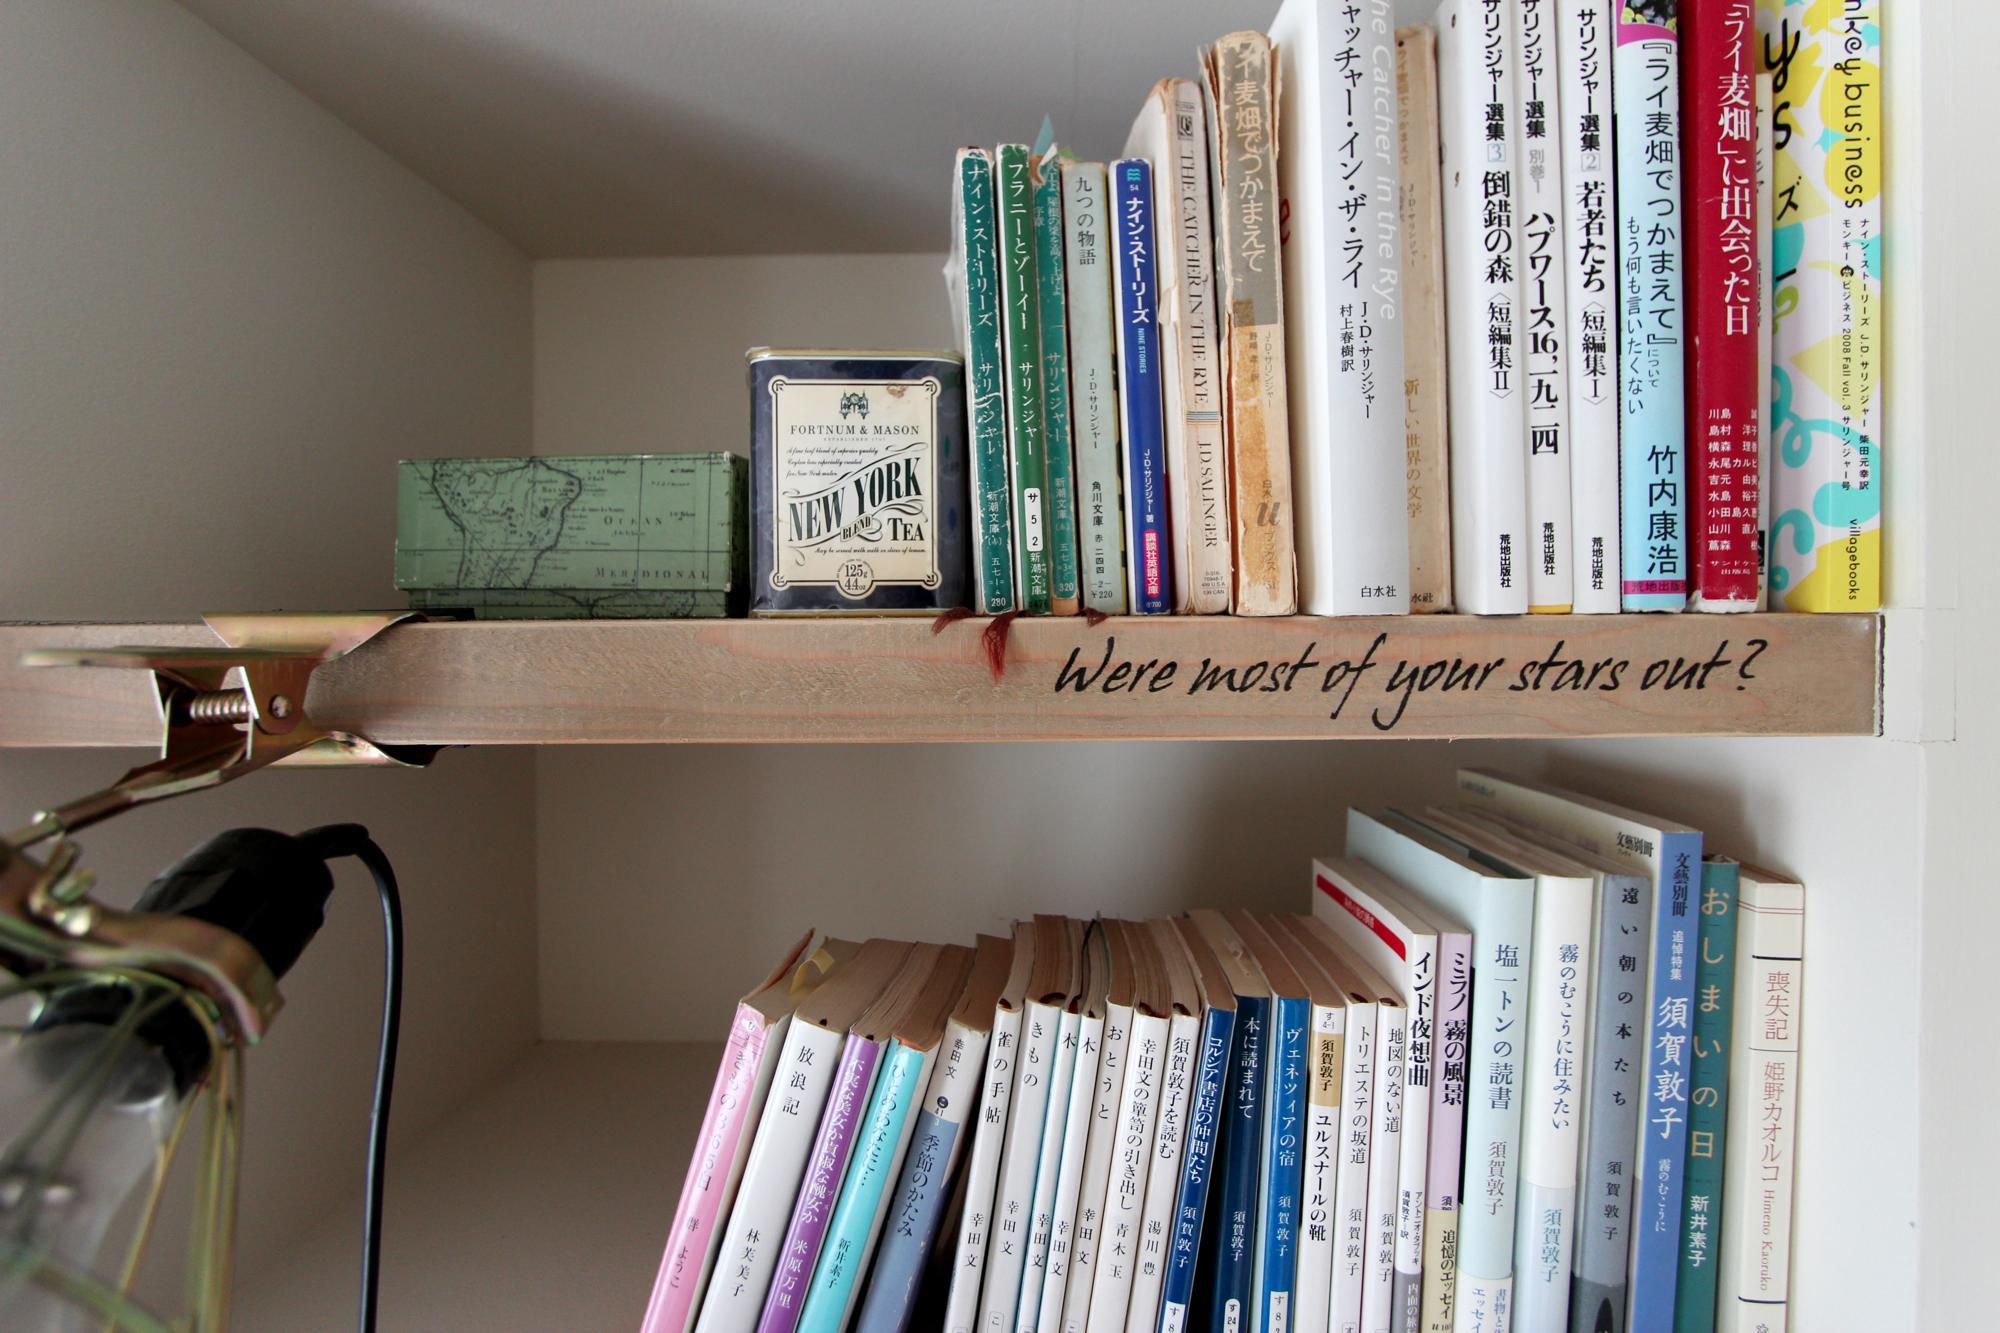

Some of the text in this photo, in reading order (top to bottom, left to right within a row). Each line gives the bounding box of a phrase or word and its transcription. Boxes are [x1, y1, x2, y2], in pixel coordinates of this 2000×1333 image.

[1484, 0, 1505, 141] サリンジャー選集
[1522, 0, 1546, 139] サリンジャー選集
[1577, 9, 1600, 152] サリンジャー選集
[1233, 42, 1264, 272] イ麦畑でつかまえて
[1334, 0, 1368, 289] ャッチャー・イン・ザ・ライ
[1717, 3, 1753, 337] 「ライ麦畑」に出会った日
[1844, 83, 1870, 209] business
[1371, 44, 1398, 321] Catcher in the Rye
[968, 168, 993, 327] ナイン・ストーリーズ
[1008, 162, 1032, 330] フラニーとゾーイー
[1075, 176, 1096, 266] 九つの物語
[1481, 170, 1514, 285] 倒錯の森
[1575, 180, 1606, 293] 若者たち
[1842, 219, 1853, 261] モンキー
[1126, 196, 1150, 325] ナイン・ストーリーズ
[1180, 150, 1210, 406] THE CATCHER IN THE RYE
[1625, 216, 1644, 415] もう何も言いたくない
[1841, 281, 1852, 323] ビジネス
[1137, 328, 1147, 374] NINE STORIES
[1340, 303, 1355, 373] 村上春樹訳
[1359, 301, 1375, 419] J・D・サリンジャー
[1842, 328, 1852, 354] 2008
[1842, 357, 1852, 378] Fall
[1858, 218, 1870, 491] ナイン・ストーリーズ 柴田元幸訳
[790, 424, 920, 436] FORTNUM & MASON
[978, 362, 998, 455] サリンジャー
[1019, 362, 1038, 456] サリンジャー
[1046, 352, 1065, 442] サリンジャー
[1708, 408, 1732, 420] 川島
[1708, 424, 1732, 436] 島村
[1842, 404, 1851, 412] 3
[1404, 378, 1422, 519] 新しい世界の文学
[1708, 441, 1732, 453] 横森
[1708, 474, 1732, 486] 吉元
[1841, 416, 1852, 491] サリンジャー号
[788, 487, 845, 542] NEW
[854, 457, 923, 517] YORK
[842, 516, 871, 540] BLEND
[887, 517, 925, 541] TEA
[986, 491, 1000, 534] 新潮文庫
[1027, 492, 1039, 503] サ
[1031, 515, 1037, 525] 5
[1091, 480, 1104, 527] 角川文庫
[1647, 444, 1679, 576] 竹内康浩
[1708, 490, 1732, 502] 水島
[1708, 524, 1732, 535] 山川
[595, 567, 708, 580] MERIDIONAL
[1030, 552, 1041, 595] 新潮文庫
[1032, 536, 1039, 546] 2
[1145, 532, 1160, 595] 講談社英語文庫
[1499, 534, 1512, 588] 荒地出版社
[1543, 522, 1555, 576] 荒地出版社
[1591, 536, 1604, 590] 荒地出版社
[1845, 518, 1861, 601] villagebooks
[1361, 585, 1397, 598] 白水社
[1054, 632, 1768, 731] Were most of your stars out?
[1616, 831, 1654, 858] 文藝別冊
[1672, 852, 1691, 917] 文藝別冊
[1669, 930, 1685, 981] 追悼特集
[1325, 1012, 1334, 1020] す
[1407, 951, 1434, 1088] インド夜想曲
[1441, 952, 1468, 1107] ミラノ 霧の風景
[1487, 944, 1520, 1110] 塩一トンの読書
[1612, 887, 1640, 1107] 遠い朝の本たち
[1691, 887, 1731, 1159] おしまいの日
[1764, 970, 1791, 1041] 喪失記
[945, 1038, 963, 1080] 幸田文
[1023, 1021, 1044, 1088] きもの
[1062, 1032, 1078, 1049] 木
[1081, 1037, 1097, 1055] 木
[1239, 1017, 1261, 1120] 本に読まれて
[1319, 1039, 1335, 1092] 須賀敦子
[1552, 944, 1580, 1130] 霧のむこうに住みたい
[1651, 996, 1689, 1140] 須賀敦子
[781, 1045, 815, 1117] 放浪記
[984, 1031, 1013, 1125] 雀の手帖
[1097, 1025, 1123, 1120] おとうと
[1159, 1037, 1192, 1160] 須賀敦子を読む
[1279, 1026, 1304, 1168] ヴェネツィアの宿
[1350, 1026, 1370, 1165] トリエステの坂道
[1384, 1028, 1404, 1133] 地図のない道
[1119, 1038, 1158, 1212] 幸田文の箪笥の引き出し
[1188, 1036, 1224, 1185] コルシア書店の仲間たち
[1761, 1061, 1786, 1182] 姫野カオルコ
[897, 1133, 941, 1239] 季節のかたみ
[1308, 1114, 1332, 1242] ユルスナールの靴
[1486, 1140, 1507, 1216] 須賀敦子
[1603, 1160, 1623, 1241] 須賀敦子
[1655, 1158, 1671, 1232] 霧のむこうに
[965, 1212, 984, 1269] 幸田文
[1000, 1200, 1020, 1256] 幸田文
[1031, 1212, 1050, 1268] 幸田文
[1050, 1221, 1070, 1277] 幸田文
[1075, 1208, 1096, 1265] 幸田文
[1109, 1222, 1129, 1280] 青木玉
[1143, 1219, 1162, 1277] 湯川豊
[1176, 1206, 1198, 1269] 須賀敦子
[1230, 1210, 1247, 1262] 須賀敦子
[1276, 1195, 1292, 1258] 須賀敦子
[1345, 1208, 1363, 1277] 須賀敦子
[1378, 1213, 1395, 1283] 須賀敦子
[1540, 1208, 1563, 1283] 須賀敦子
[1687, 1195, 1710, 1268] 新井素子
[1759, 1189, 1775, 1292] Himeno Kaoruko
[731, 1227, 761, 1298] 林芙美子
[778, 1239, 809, 1309] 米原万里
[826, 1237, 851, 1289] 新井素子
[1440, 1230, 1456, 1320] 追憶のエッセイ
[1168, 1305, 1180, 1317] す
[1168, 1323, 1175, 1333] 8
[1227, 1316, 1237, 1325] 24
[1228, 1303, 1237, 1312] す
[1274, 1294, 1285, 1306] す
[1275, 1310, 1282, 1323] 8
